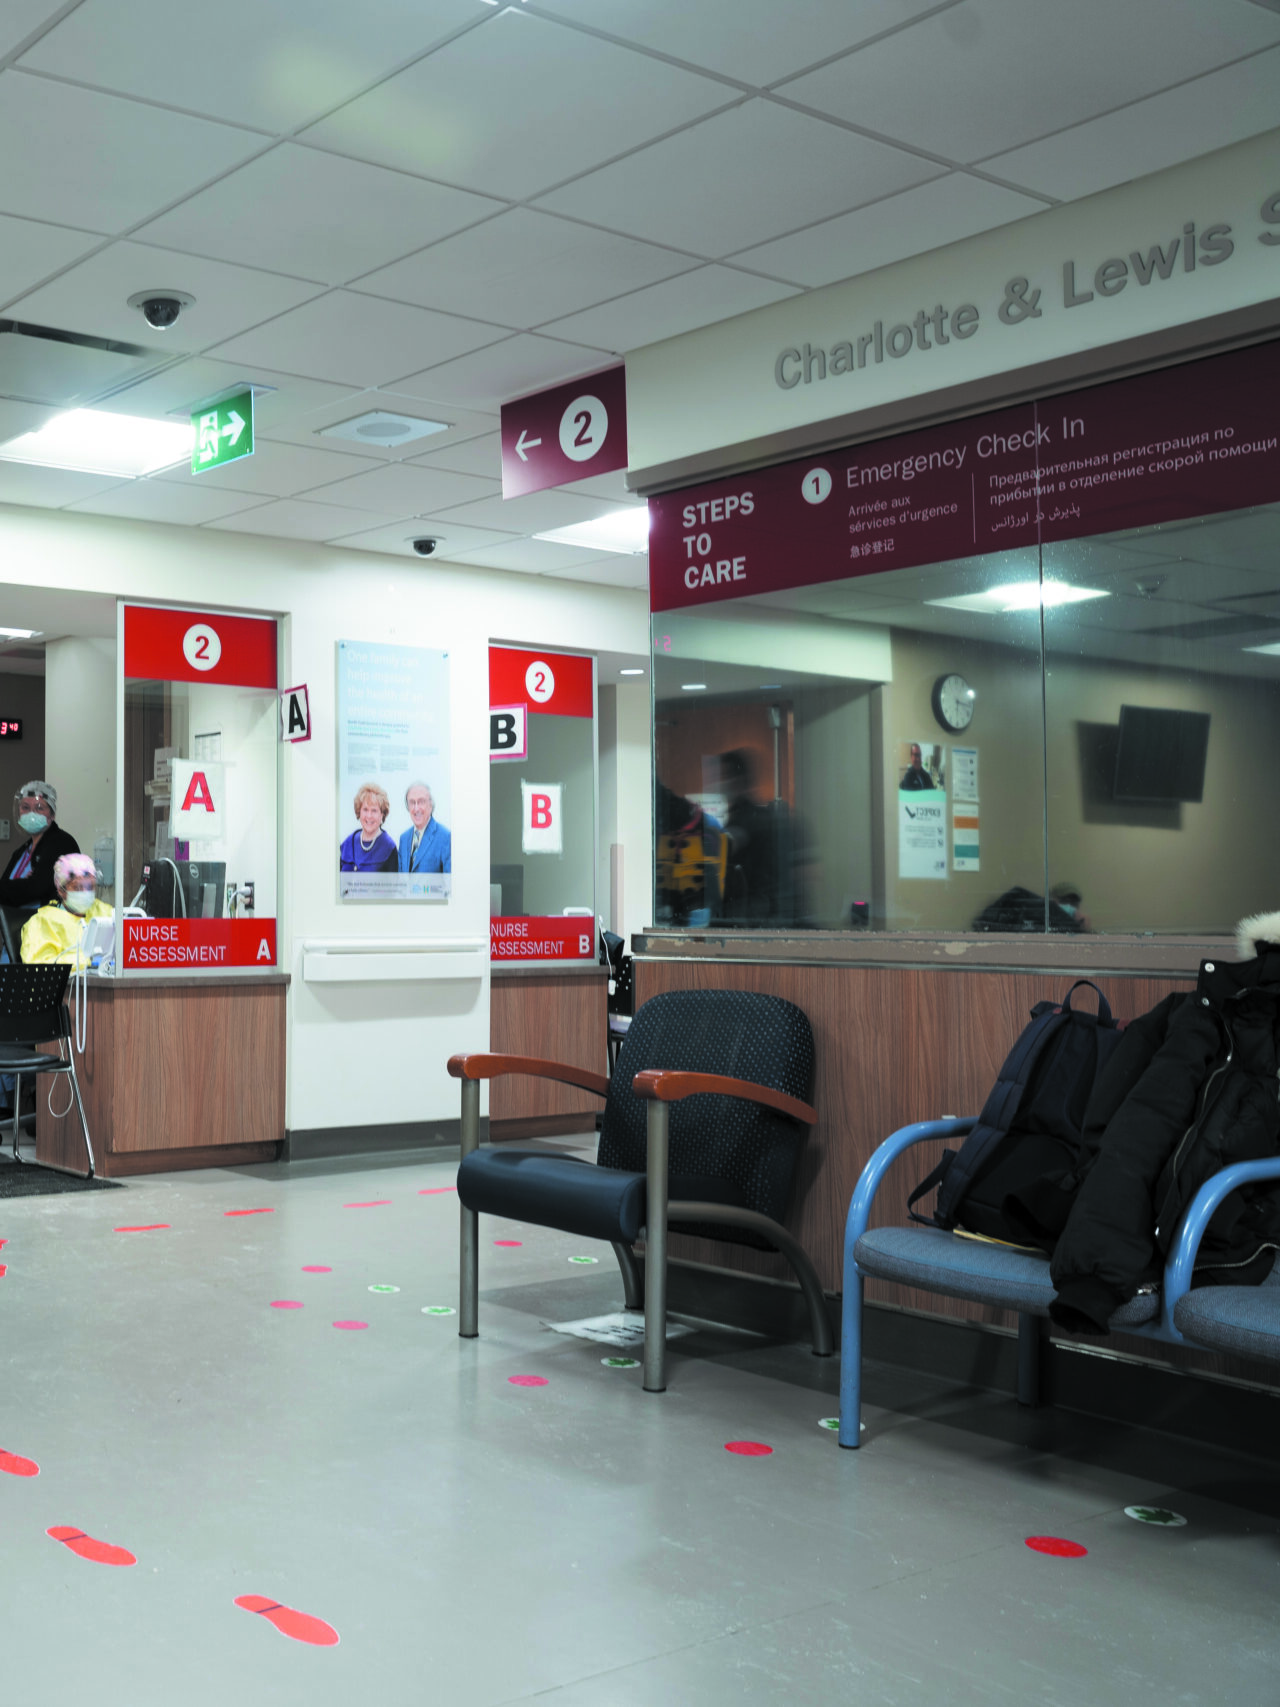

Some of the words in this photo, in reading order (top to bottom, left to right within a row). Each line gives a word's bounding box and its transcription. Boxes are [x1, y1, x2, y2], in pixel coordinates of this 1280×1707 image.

[774, 303, 979, 389] Charlotte
[997, 275, 1043, 326] &
[1063, 222, 1235, 308] Lewis
[574, 411, 592, 446] 2
[846, 445, 967, 488] Emergency
[976, 422, 1051, 459] Check
[1062, 415, 1085, 440] In
[989, 452, 1109, 489] Предварительная
[1113, 431, 1209, 465] регистрация
[1214, 426, 1235, 441] по
[810, 476, 821, 495] 1
[989, 482, 1055, 507] прибытии
[1058, 481, 1066, 492] в
[1070, 464, 1144, 490] отделение
[1148, 450, 1204, 474] скорой
[1208, 436, 1277, 462] помощи
[682, 491, 756, 529] STEPS
[848, 496, 888, 518] Arrivée
[891, 495, 911, 509] aux
[849, 516, 896, 534] sérvices
[899, 502, 958, 524] d'urgence
[683, 531, 712, 560] TO
[849, 538, 895, 559] 急诊登记
[683, 556, 747, 590] CARE
[194, 635, 211, 660] 2
[534, 671, 546, 693] 2
[289, 694, 307, 737] A
[489, 713, 517, 750] B
[181, 771, 215, 813] A
[531, 793, 553, 829] B
[129, 926, 178, 941] NURSE
[490, 923, 528, 937] NURSE
[490, 940, 564, 955] ASSESSMENT
[579, 935, 590, 953] B
[128, 945, 226, 961] ASSESSMENT
[257, 939, 271, 959] A
